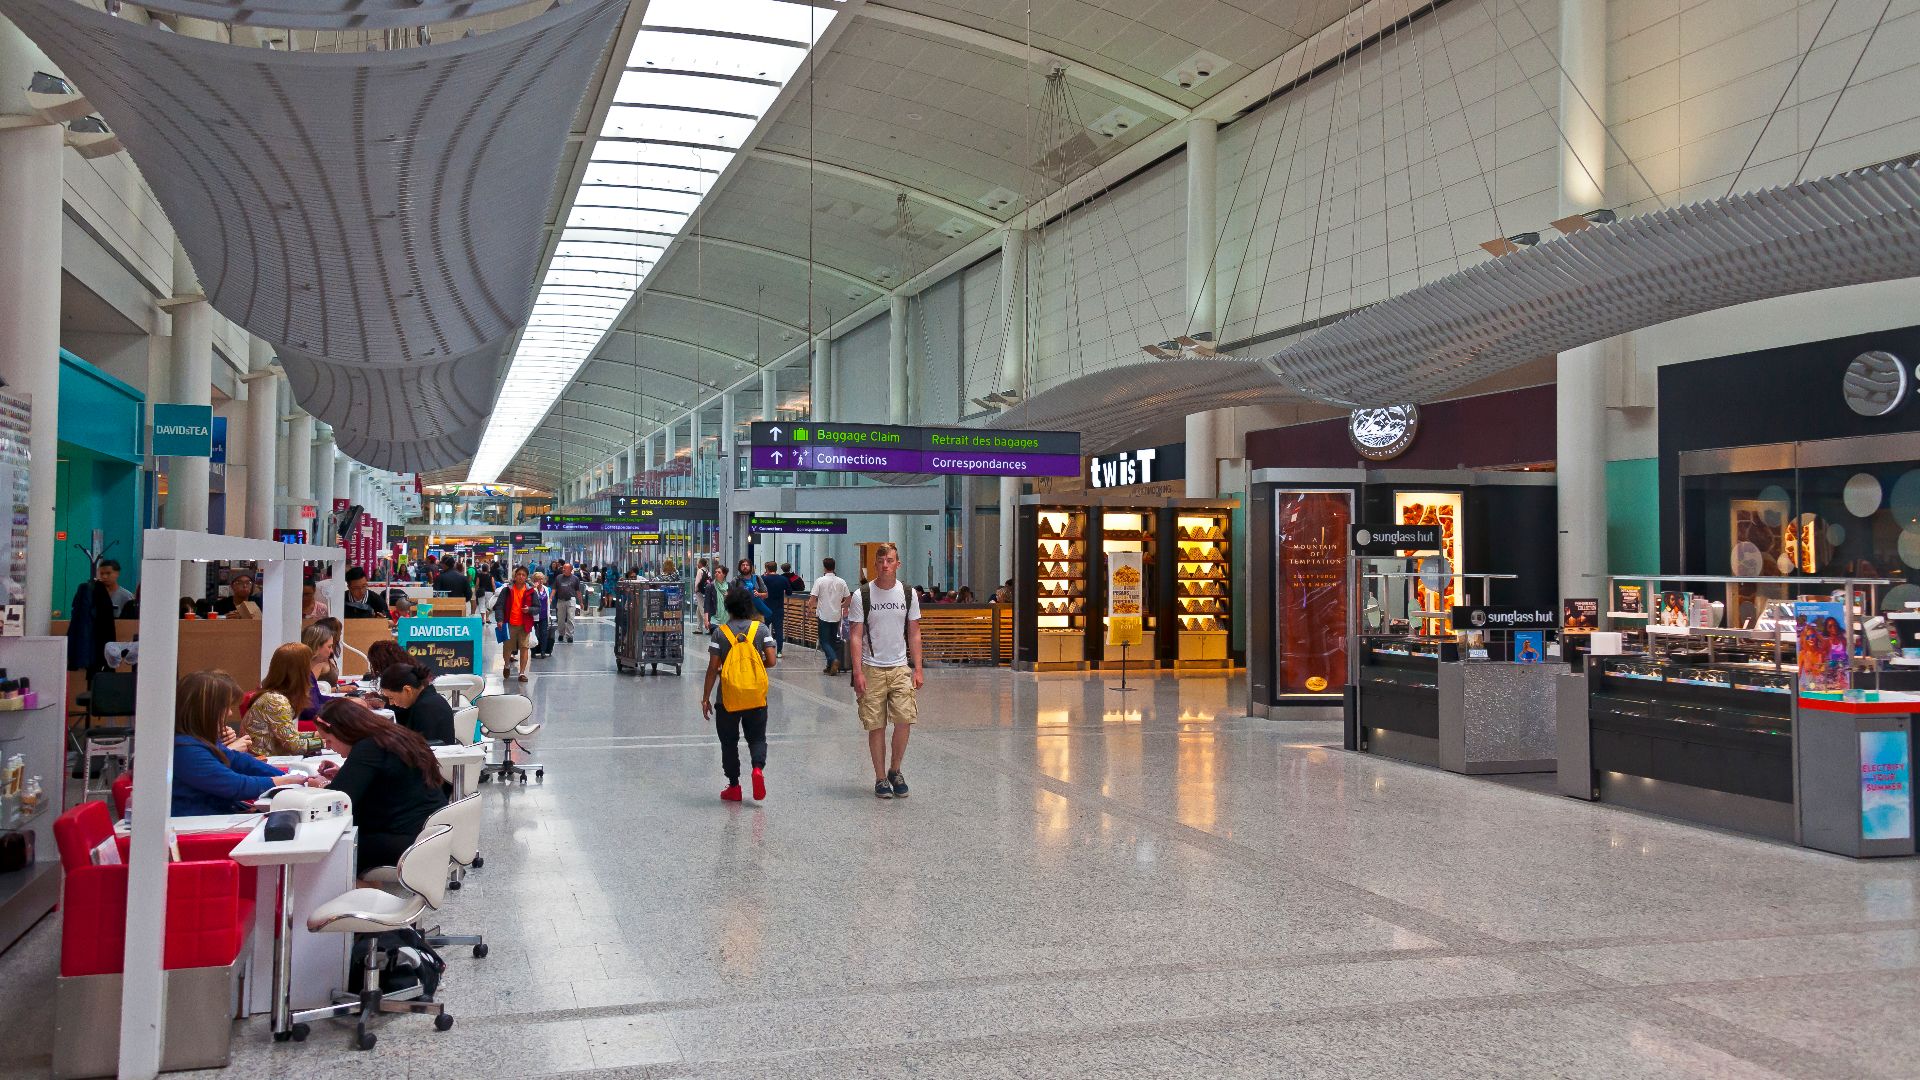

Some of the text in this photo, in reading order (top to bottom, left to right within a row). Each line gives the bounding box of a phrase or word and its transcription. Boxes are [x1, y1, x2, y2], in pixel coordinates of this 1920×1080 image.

[156, 425, 209, 436] DAVIDsTEA
[817, 429, 900, 443] Baggage Claim
[932, 434, 1039, 449] Retrait des bagages
[817, 453, 888, 466] Connections
[932, 457, 1027, 470] Correspondances
[1372, 530, 1434, 545] sunglass hut
[871, 602, 899, 610] NIXON
[1488, 610, 1554, 626] sunglass hut
[410, 625, 470, 637] DAVIDsTEA
[1862, 763, 1905, 773] ELECTRIFY
